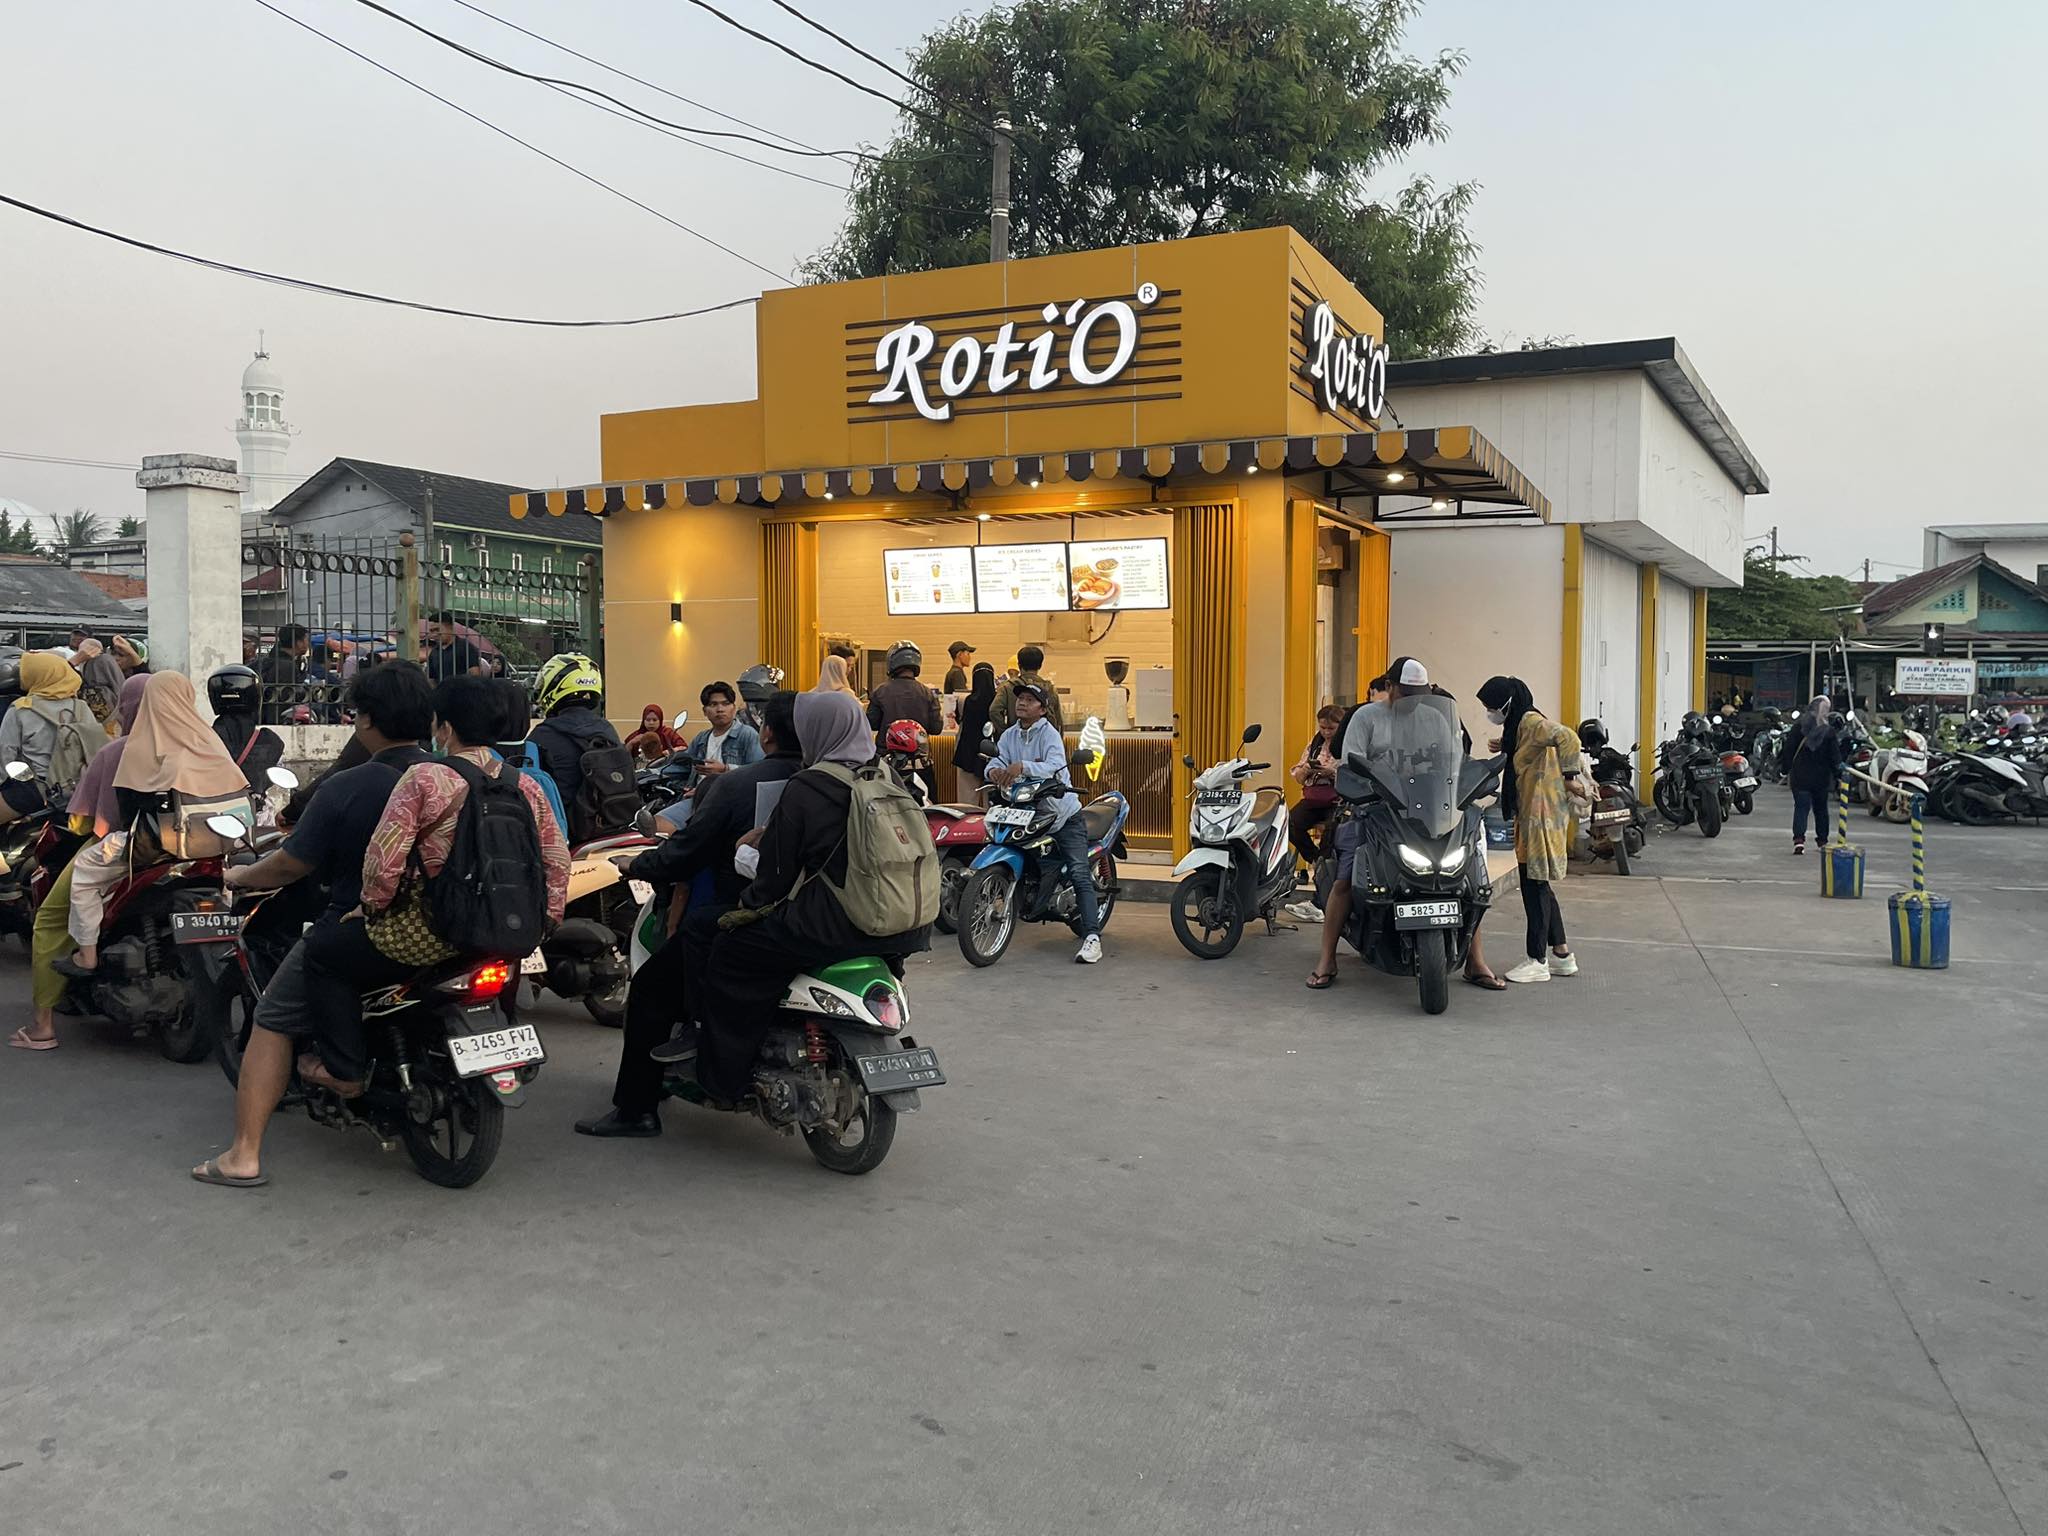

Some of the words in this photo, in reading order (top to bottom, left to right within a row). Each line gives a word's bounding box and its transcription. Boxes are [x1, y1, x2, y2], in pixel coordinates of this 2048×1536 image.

[1398, 907, 1404, 917] B
[1411, 905, 1435, 916] 5825
[1439, 903, 1457, 914] FJY
[176, 917, 184, 928] B
[191, 916, 221, 927] 3940
[453, 1041, 463, 1055] B
[470, 1033, 506, 1052] 3469
[508, 1027, 535, 1045] FVZ
